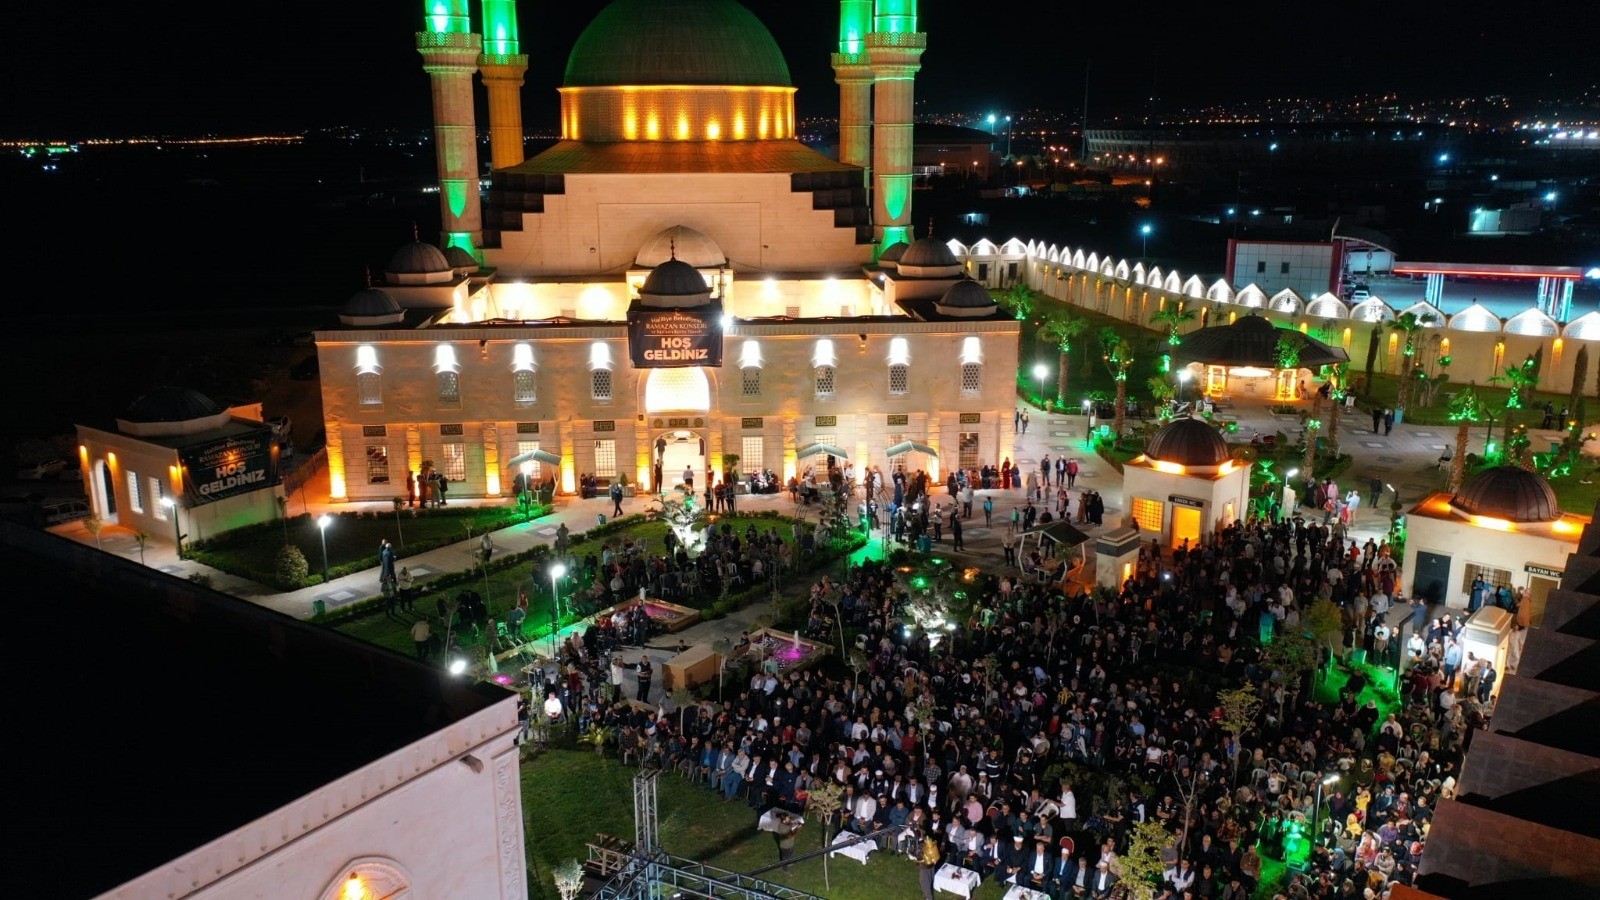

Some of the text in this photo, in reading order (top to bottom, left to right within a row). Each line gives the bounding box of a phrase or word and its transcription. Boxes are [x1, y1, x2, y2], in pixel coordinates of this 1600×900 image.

[661, 338, 692, 350] HOŞ
[644, 349, 708, 360] GELDİNİZ
[216, 462, 246, 478] HOŞ
[200, 470, 266, 495] GELDİNİZ
[1528, 566, 1549, 574] BAYAN
